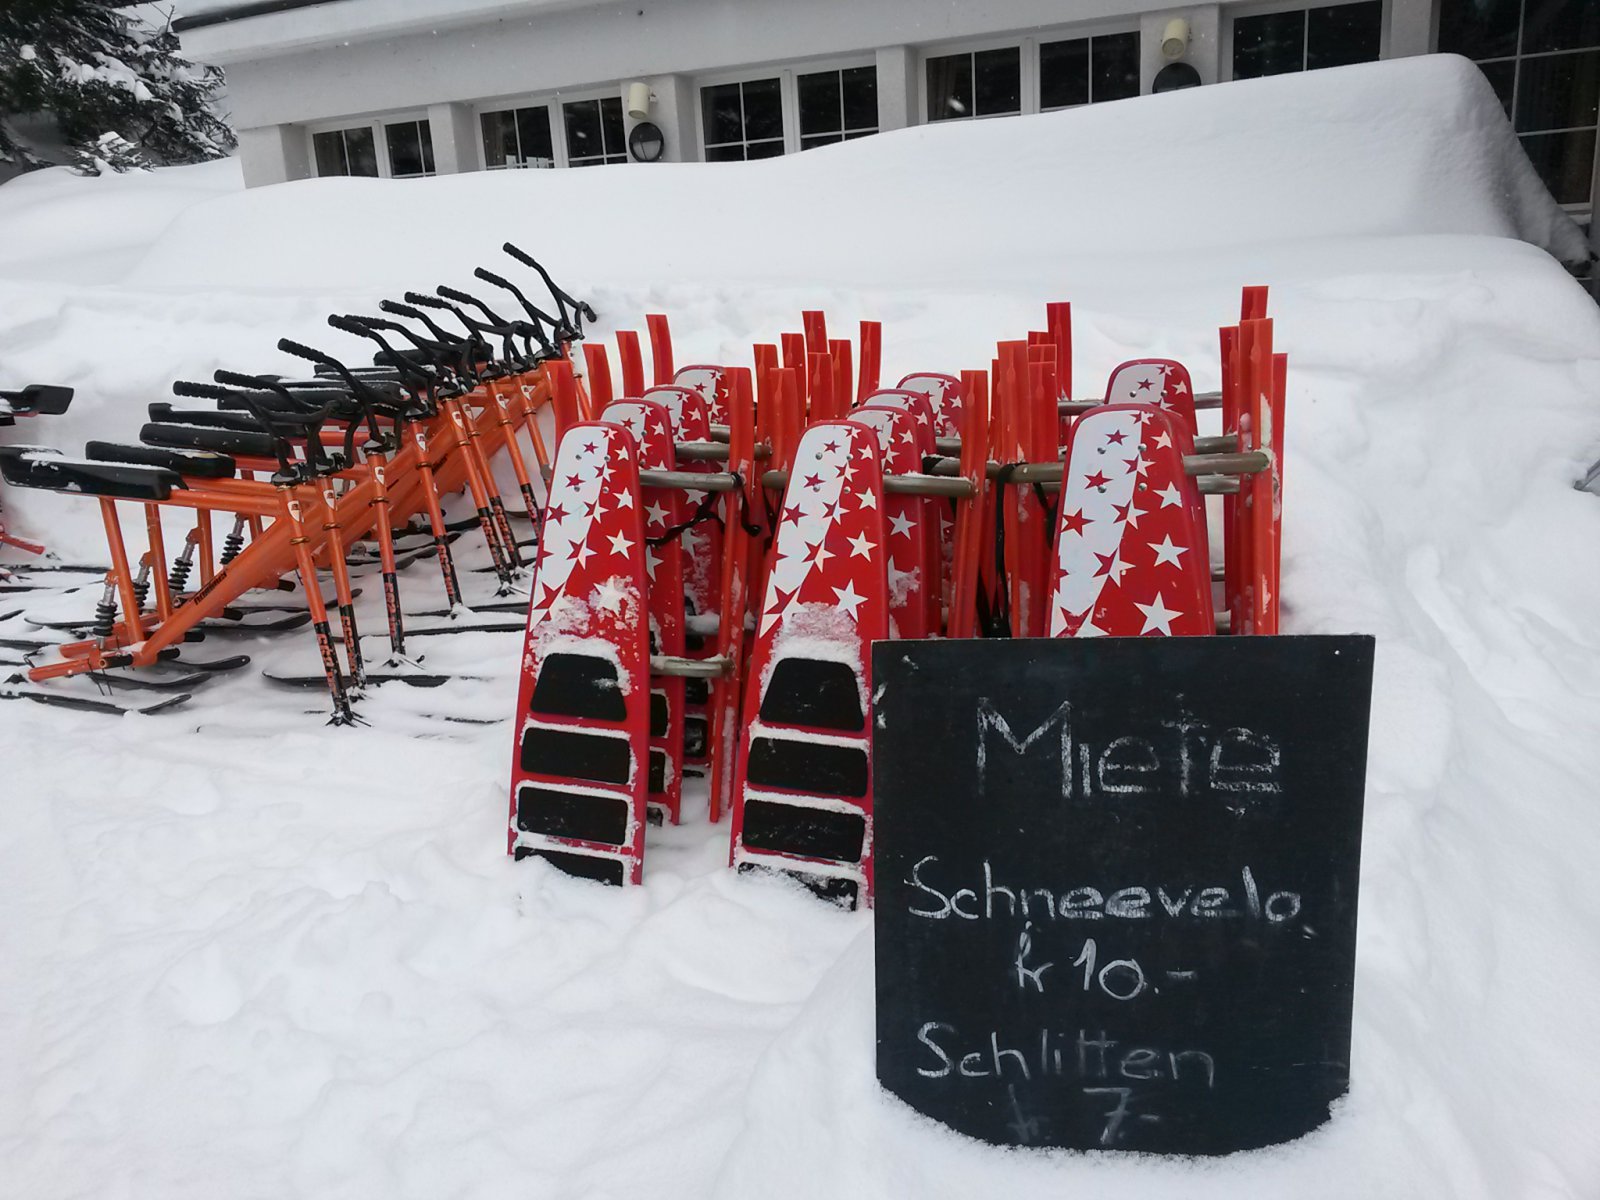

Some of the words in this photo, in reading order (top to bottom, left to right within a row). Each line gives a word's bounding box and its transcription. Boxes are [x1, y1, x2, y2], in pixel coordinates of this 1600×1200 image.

[975, 696, 1283, 799] Miete
[905, 855, 1301, 922] Schneevelo
[917, 1021, 1215, 1088] Schlitten
